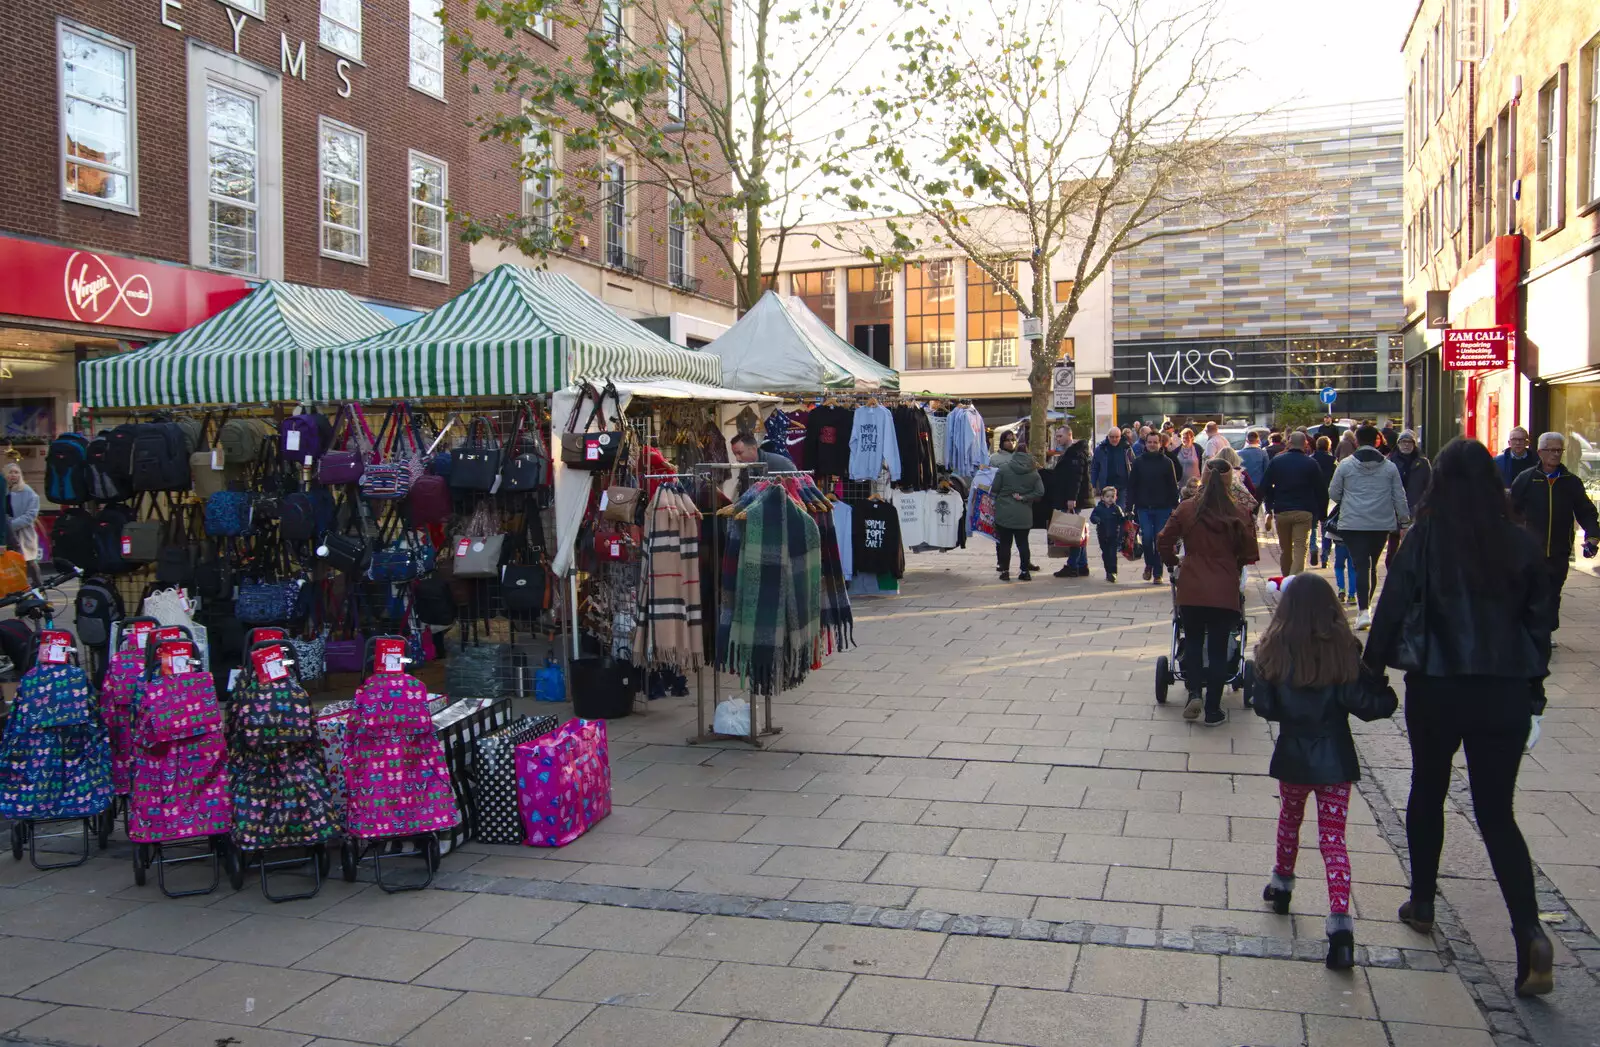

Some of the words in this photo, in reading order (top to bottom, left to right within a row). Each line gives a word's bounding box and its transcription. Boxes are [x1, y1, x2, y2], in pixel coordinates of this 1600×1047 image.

[71, 263, 111, 312] Virgin
[126, 289, 149, 299] media
[1448, 332, 1474, 342] ZAM
[1474, 331, 1505, 341] CALL
[1147, 349, 1234, 385] M&S
[265, 651, 280, 661] sale
